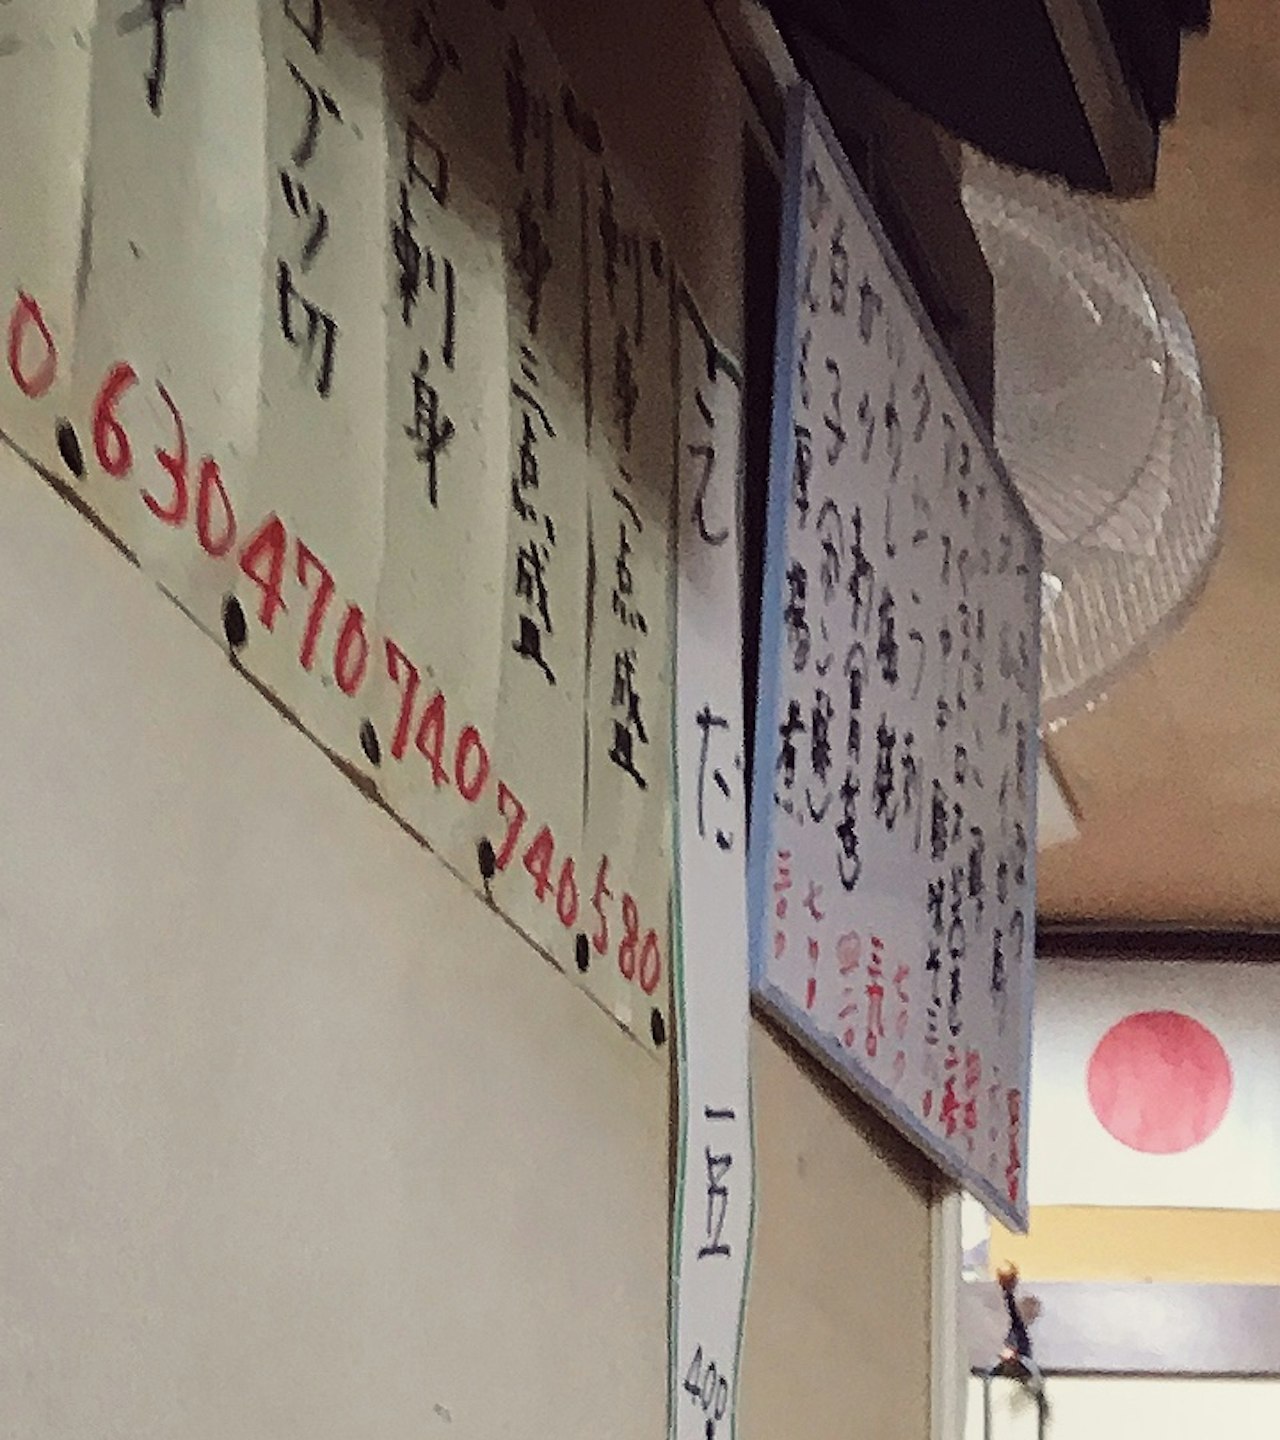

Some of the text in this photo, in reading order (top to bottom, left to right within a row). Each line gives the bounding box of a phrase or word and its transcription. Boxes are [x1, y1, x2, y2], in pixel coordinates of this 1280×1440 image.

[92, 361, 238, 557] 630
[239, 512, 369, 697] 470
[384, 637, 489, 802] 740
[497, 781, 579, 927] 740
[591, 853, 661, 995] 580
